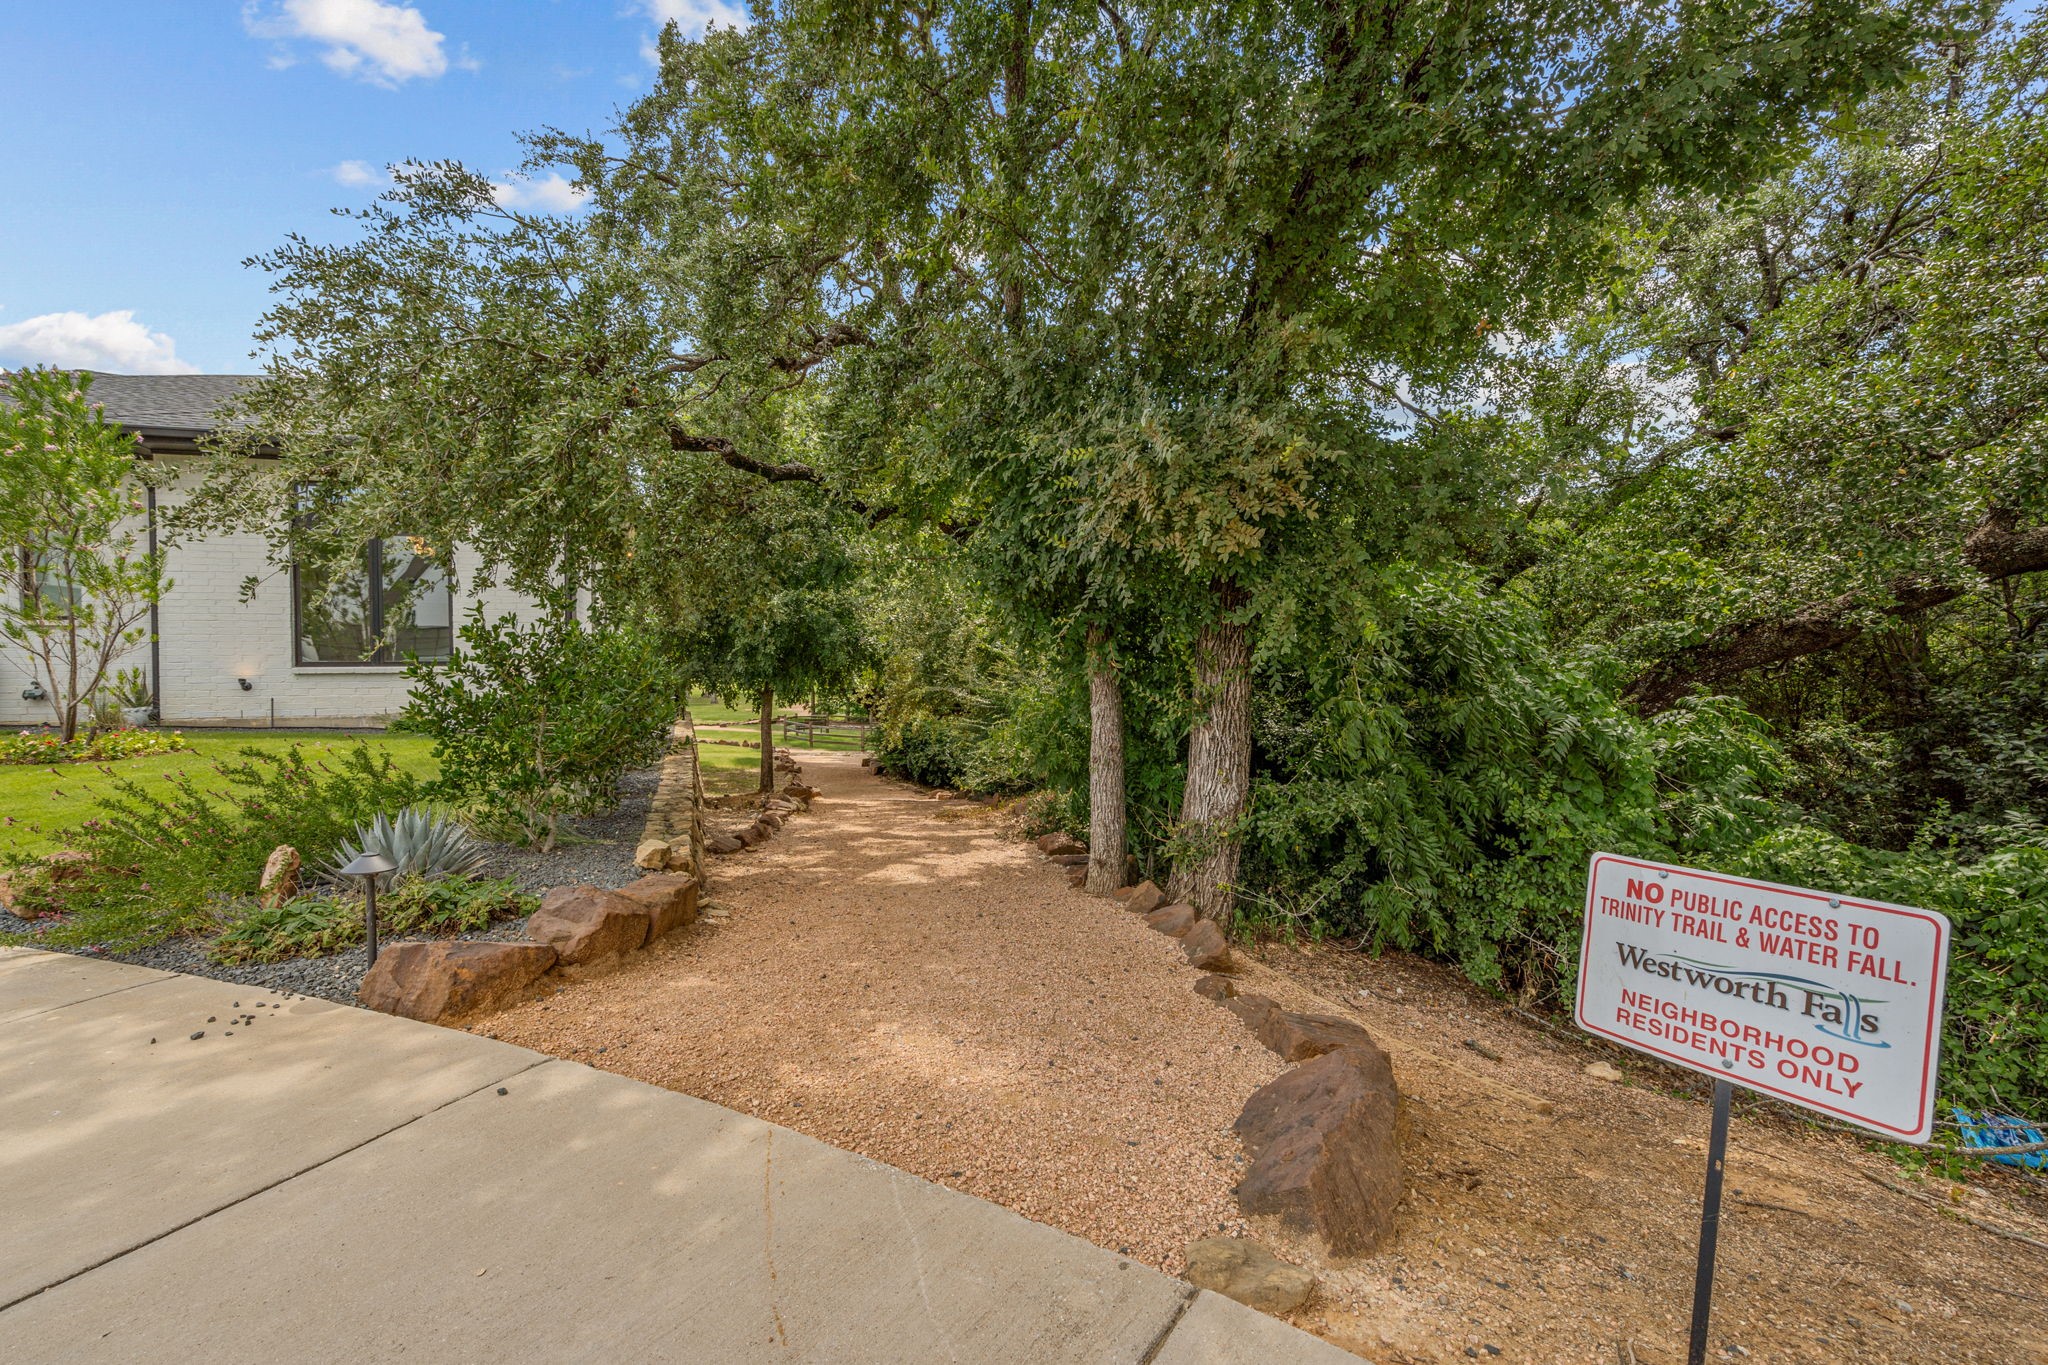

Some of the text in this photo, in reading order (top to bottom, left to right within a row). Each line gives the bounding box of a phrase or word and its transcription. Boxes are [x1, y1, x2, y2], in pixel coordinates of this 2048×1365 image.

[1600, 896, 1917, 987] TRINITY TRAIL & WATER FALL.
[1626, 878, 1880, 950] NO PUBLIC ACCESS TO
[1615, 941, 1880, 1039] Westworth Falls
[1621, 988, 1860, 1074] NEIGHBORHOOD
[1616, 1007, 1863, 1099] RESIDENTS ONLY
